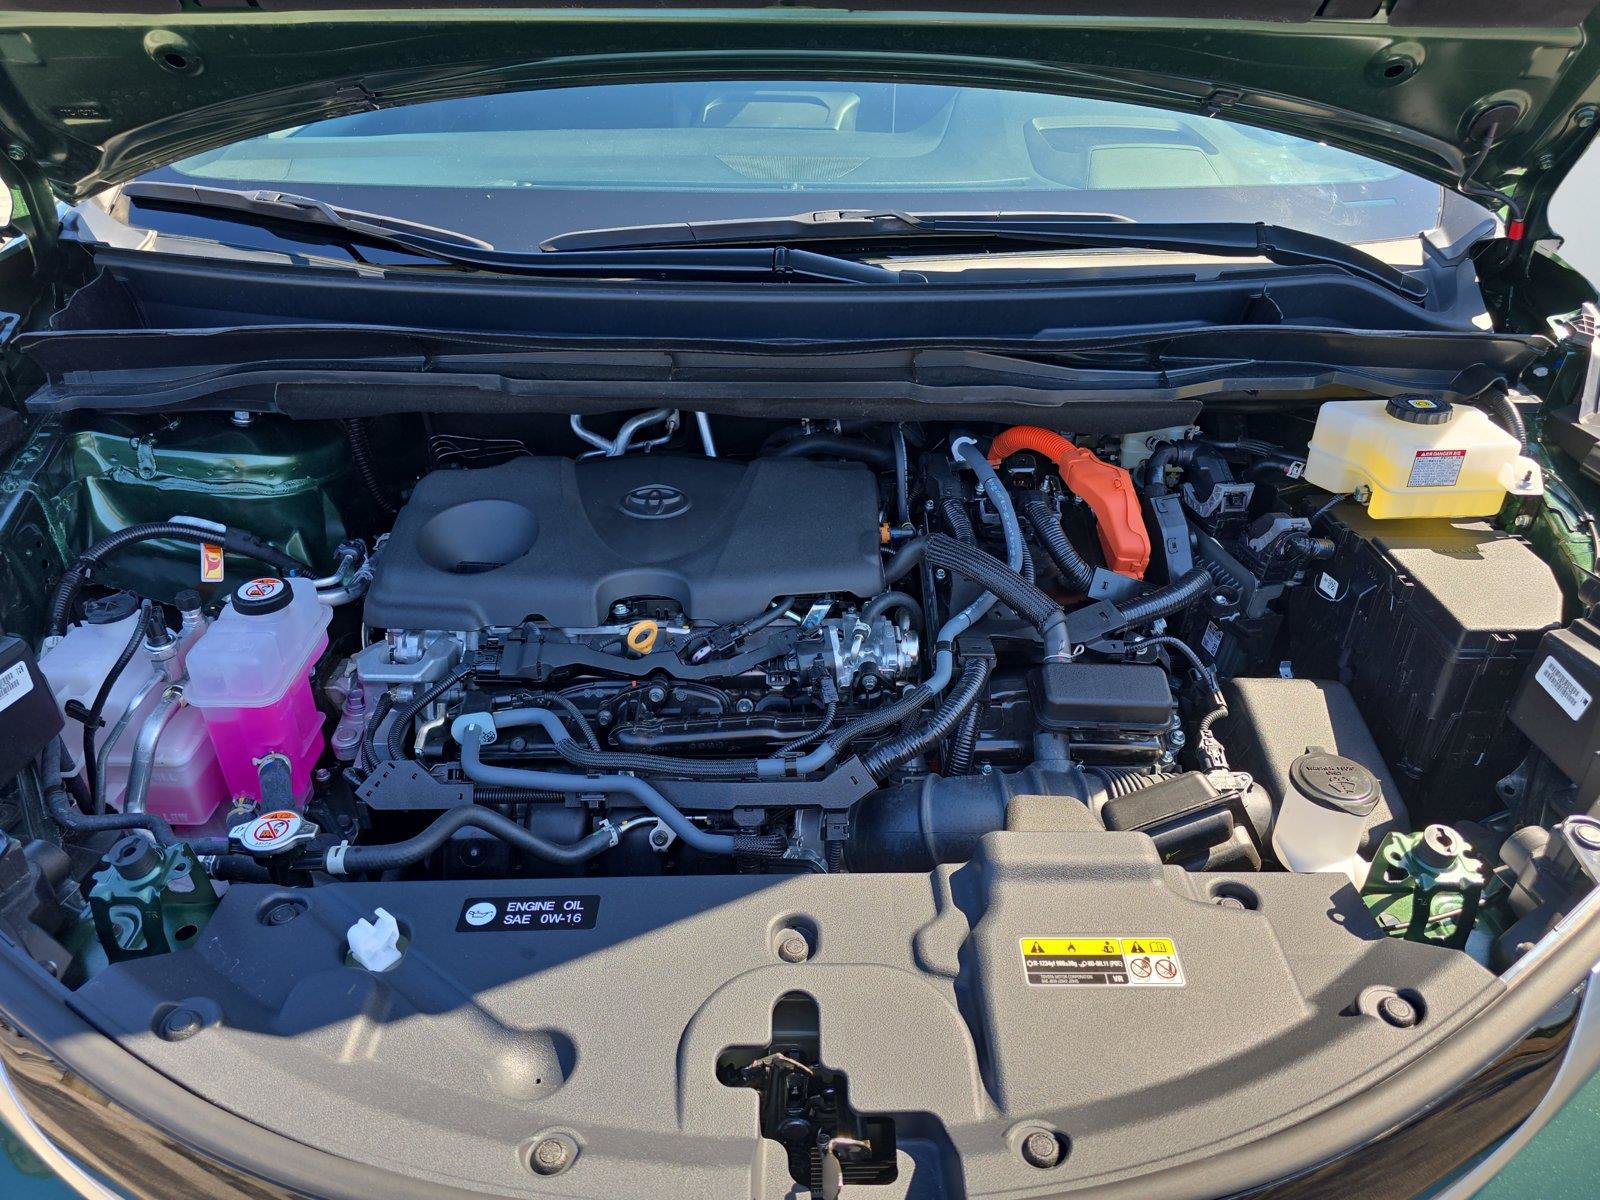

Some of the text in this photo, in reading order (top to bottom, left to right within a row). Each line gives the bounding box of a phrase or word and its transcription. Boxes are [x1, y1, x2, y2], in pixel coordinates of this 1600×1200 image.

[507, 901, 584, 911] ENGINE OIL
[503, 913, 581, 924] SAE 0W-16
